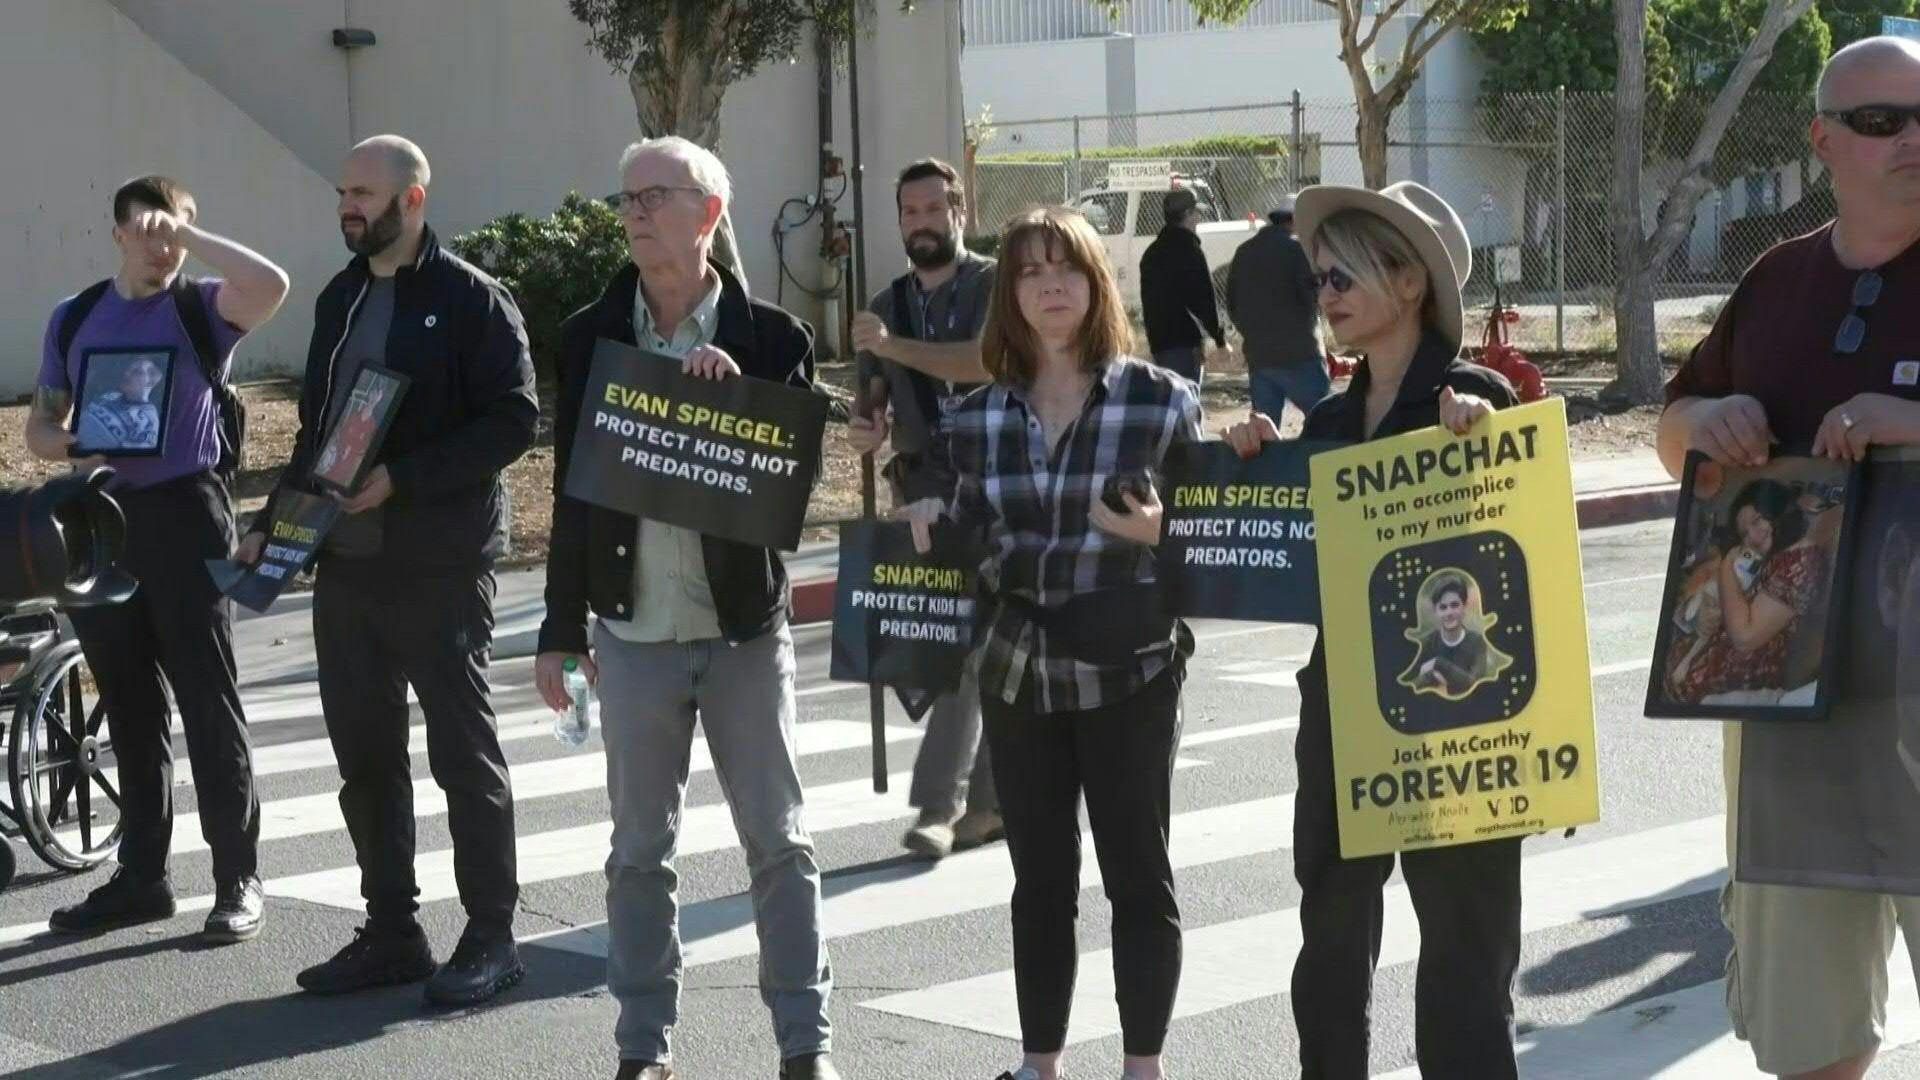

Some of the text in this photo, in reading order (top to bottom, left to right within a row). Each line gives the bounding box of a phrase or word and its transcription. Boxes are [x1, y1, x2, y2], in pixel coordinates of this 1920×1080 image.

[1122, 165, 1168, 177] TRESPASSING
[604, 382, 795, 449] EVAN SPIEGEL:
[595, 411, 799, 476] PROTECT KIDS NOT
[1335, 424, 1537, 502] SNAPCHAT
[622, 446, 752, 494] PREDATORS.
[1174, 485, 1218, 507] EVAN
[1363, 475, 1515, 520] Is an accomplice
[1168, 519, 1316, 541] PROTECT KIDS NO
[1377, 502, 1506, 542] to my murder
[1185, 547, 1293, 569] PREDATORS.
[852, 590, 927, 612] PROTECT
[928, 597, 955, 616] KIDS
[1392, 729, 1530, 765] Jack McCarthy
[1351, 744, 1579, 811] FOREVER 19
